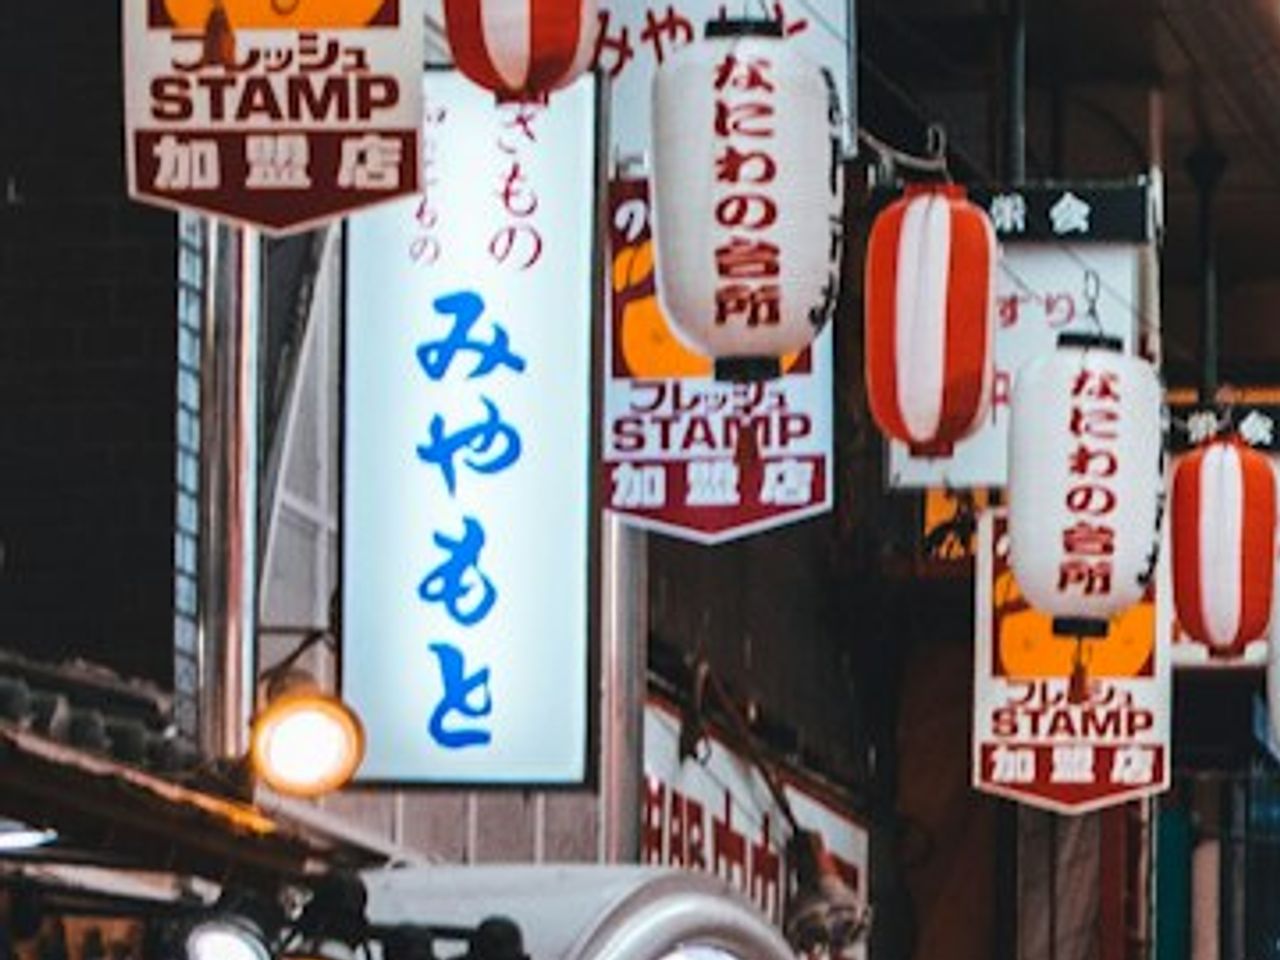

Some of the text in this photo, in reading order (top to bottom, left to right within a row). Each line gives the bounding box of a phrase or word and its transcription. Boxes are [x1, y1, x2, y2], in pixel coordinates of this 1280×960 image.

[170, 36, 372, 73] フレッシュ
[150, 76, 399, 123] STAMP
[153, 136, 402, 191] 加盟店
[612, 414, 812, 452] STAMP
[611, 459, 815, 508] 加盟店
[417, 291, 527, 750] みやもと
[991, 709, 1154, 739] STAMP
[990, 747, 1156, 784] 加盟店
